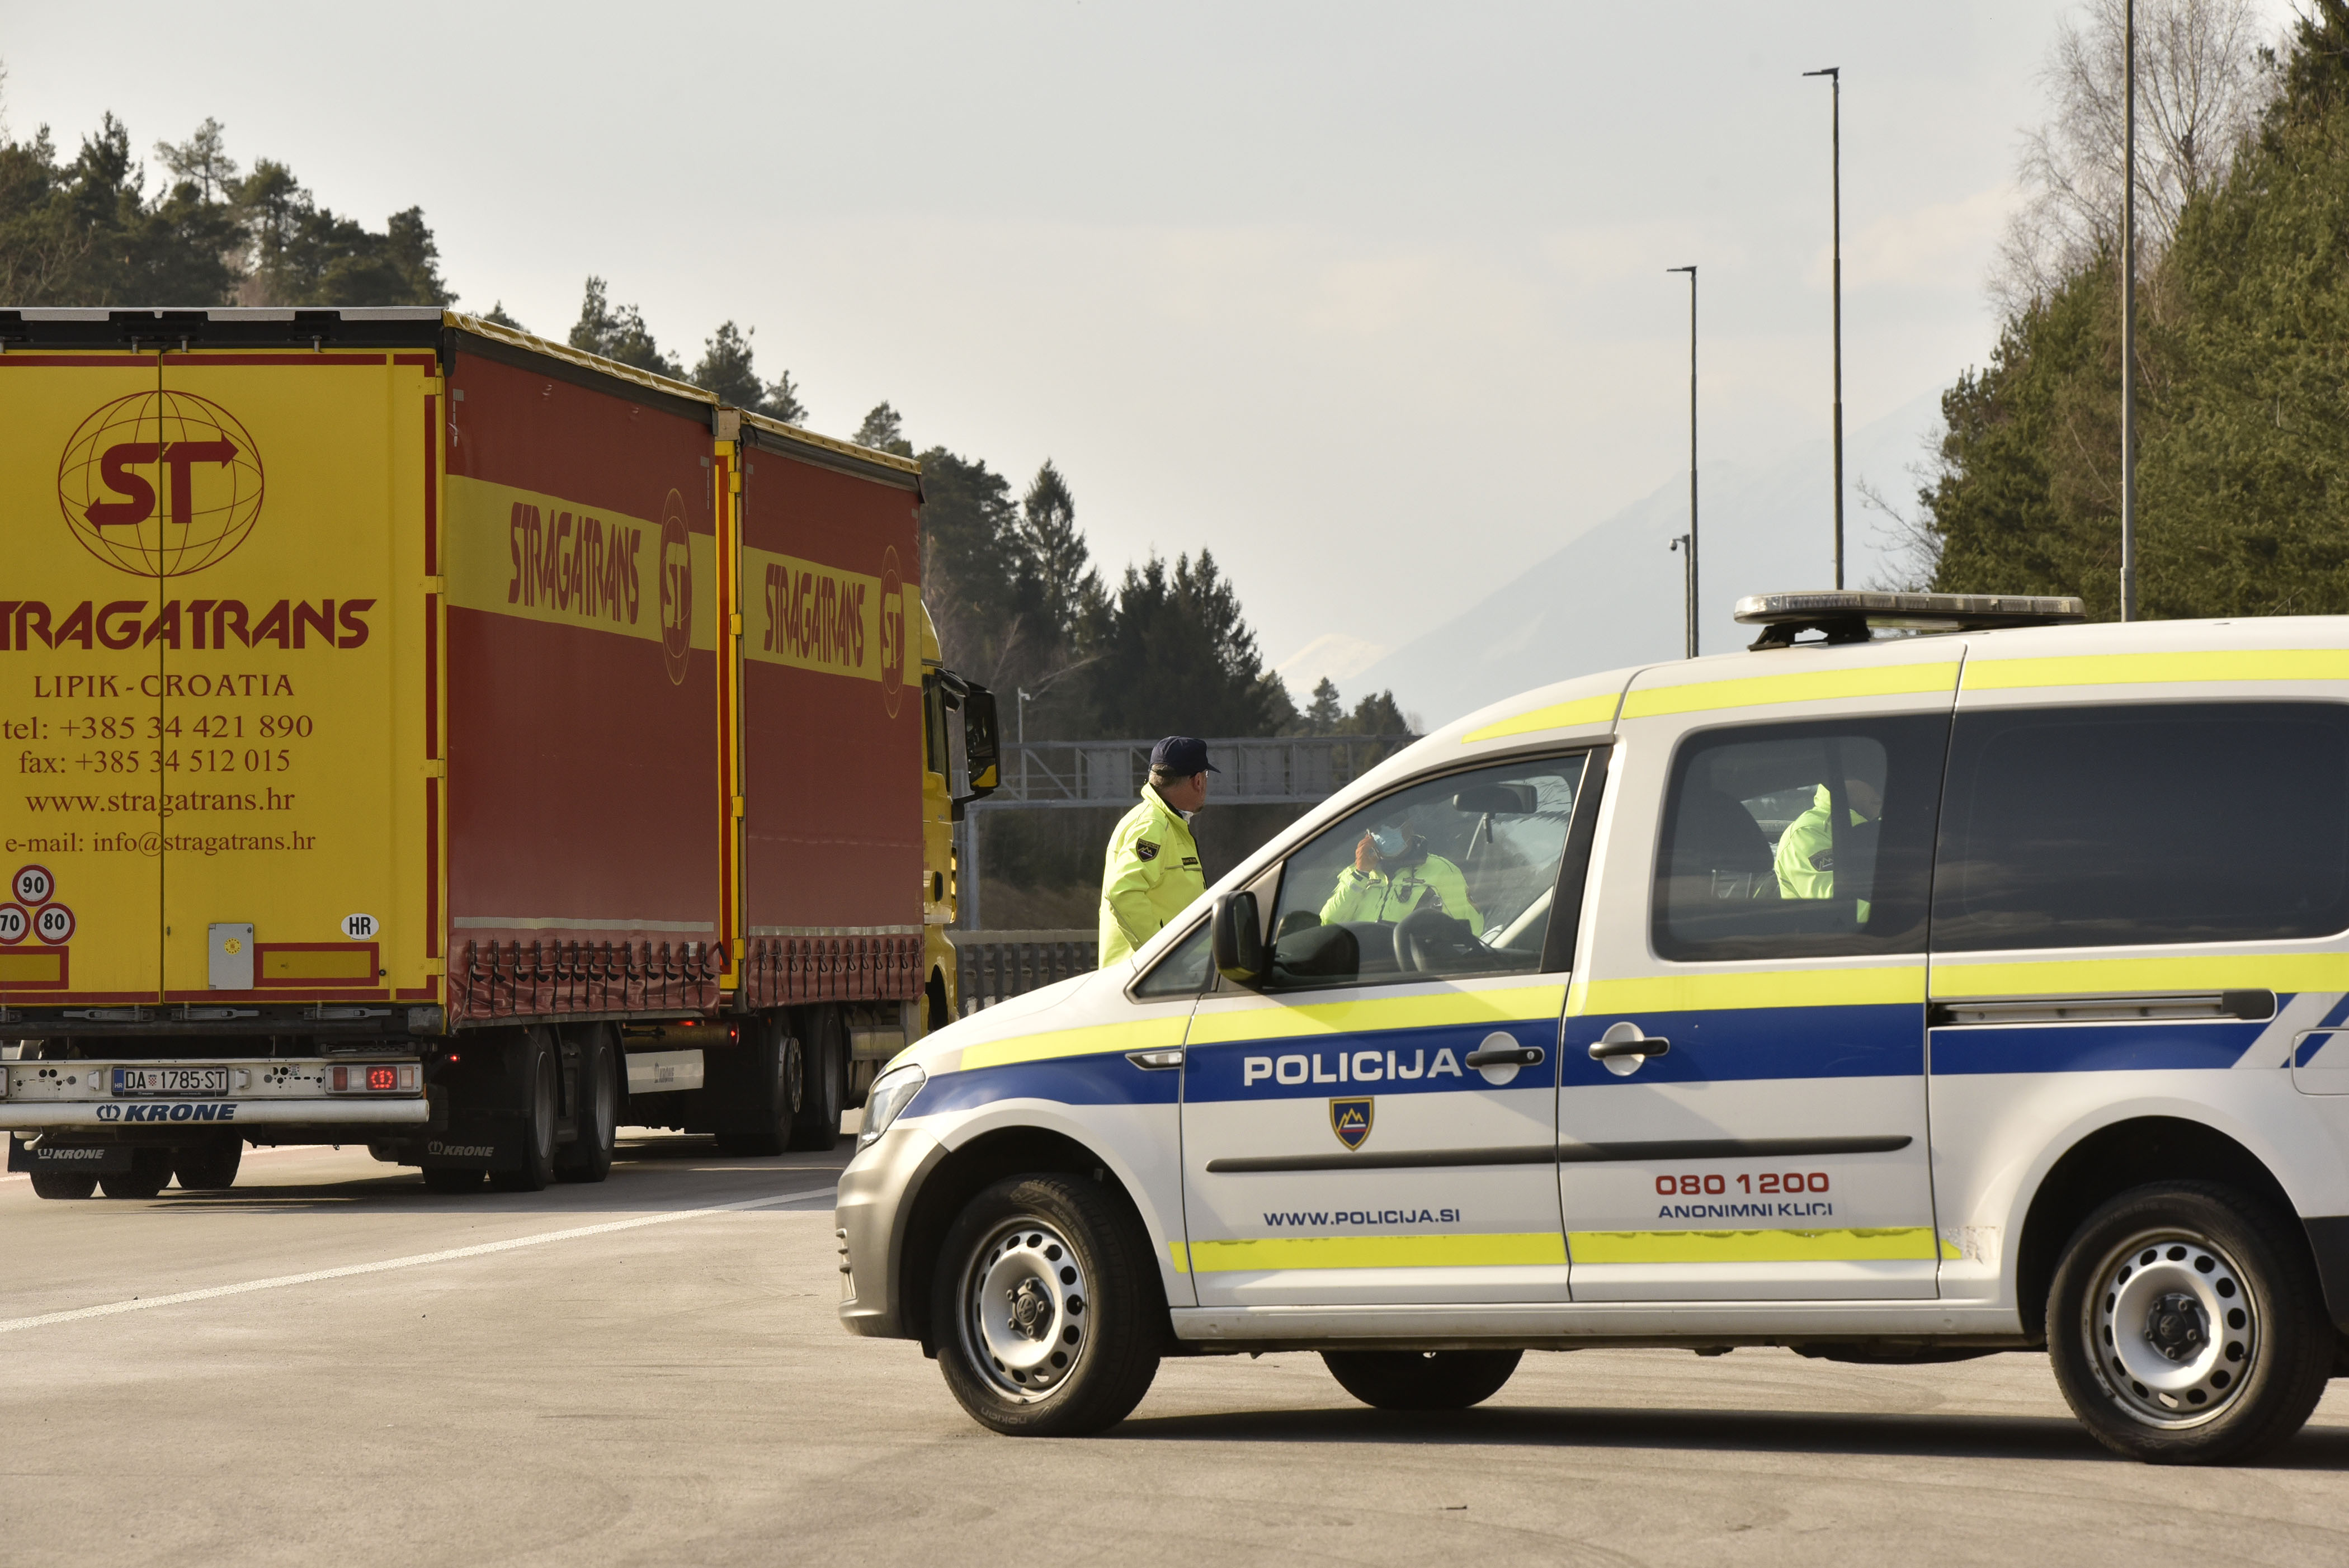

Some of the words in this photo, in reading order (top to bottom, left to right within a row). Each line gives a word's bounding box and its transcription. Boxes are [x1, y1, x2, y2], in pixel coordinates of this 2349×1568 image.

[83, 432, 239, 531] ST
[508, 501, 641, 625] STRAGATRANS
[764, 563, 865, 668] STRAGATRANS
[3, 717, 49, 740] tel:
[60, 716, 135, 740] +385
[147, 716, 182, 739] 34
[193, 715, 244, 739] 421
[260, 715, 313, 738] 890
[19, 751, 66, 774] fax:
[76, 751, 139, 773] +385
[150, 750, 180, 773] 34
[190, 750, 235, 772] 512
[244, 749, 290, 772] 015
[26, 787, 295, 818] www.stragatrans.hr
[6, 833, 84, 853] e-mail:
[93, 832, 316, 856] info@stragatrans.hr
[23, 876, 44, 894] 90
[0, 914, 20, 932] 70
[44, 913, 65, 931] 80
[349, 917, 371, 935] HR
[1243, 1048, 1463, 1086] POLICIJA
[125, 1071, 147, 1089] DA
[124, 1104, 238, 1121] KRONE
[53, 1149, 105, 1159] KRONE
[442, 1145, 494, 1156] KRONE
[1655, 1174, 1725, 1195] 080
[1736, 1172, 1829, 1194] 1200
[1263, 1209, 1460, 1226] WWW.POLICIJA.SI
[1658, 1203, 1773, 1218] ANONIMNI
[981, 1405, 1028, 1425] nokian
